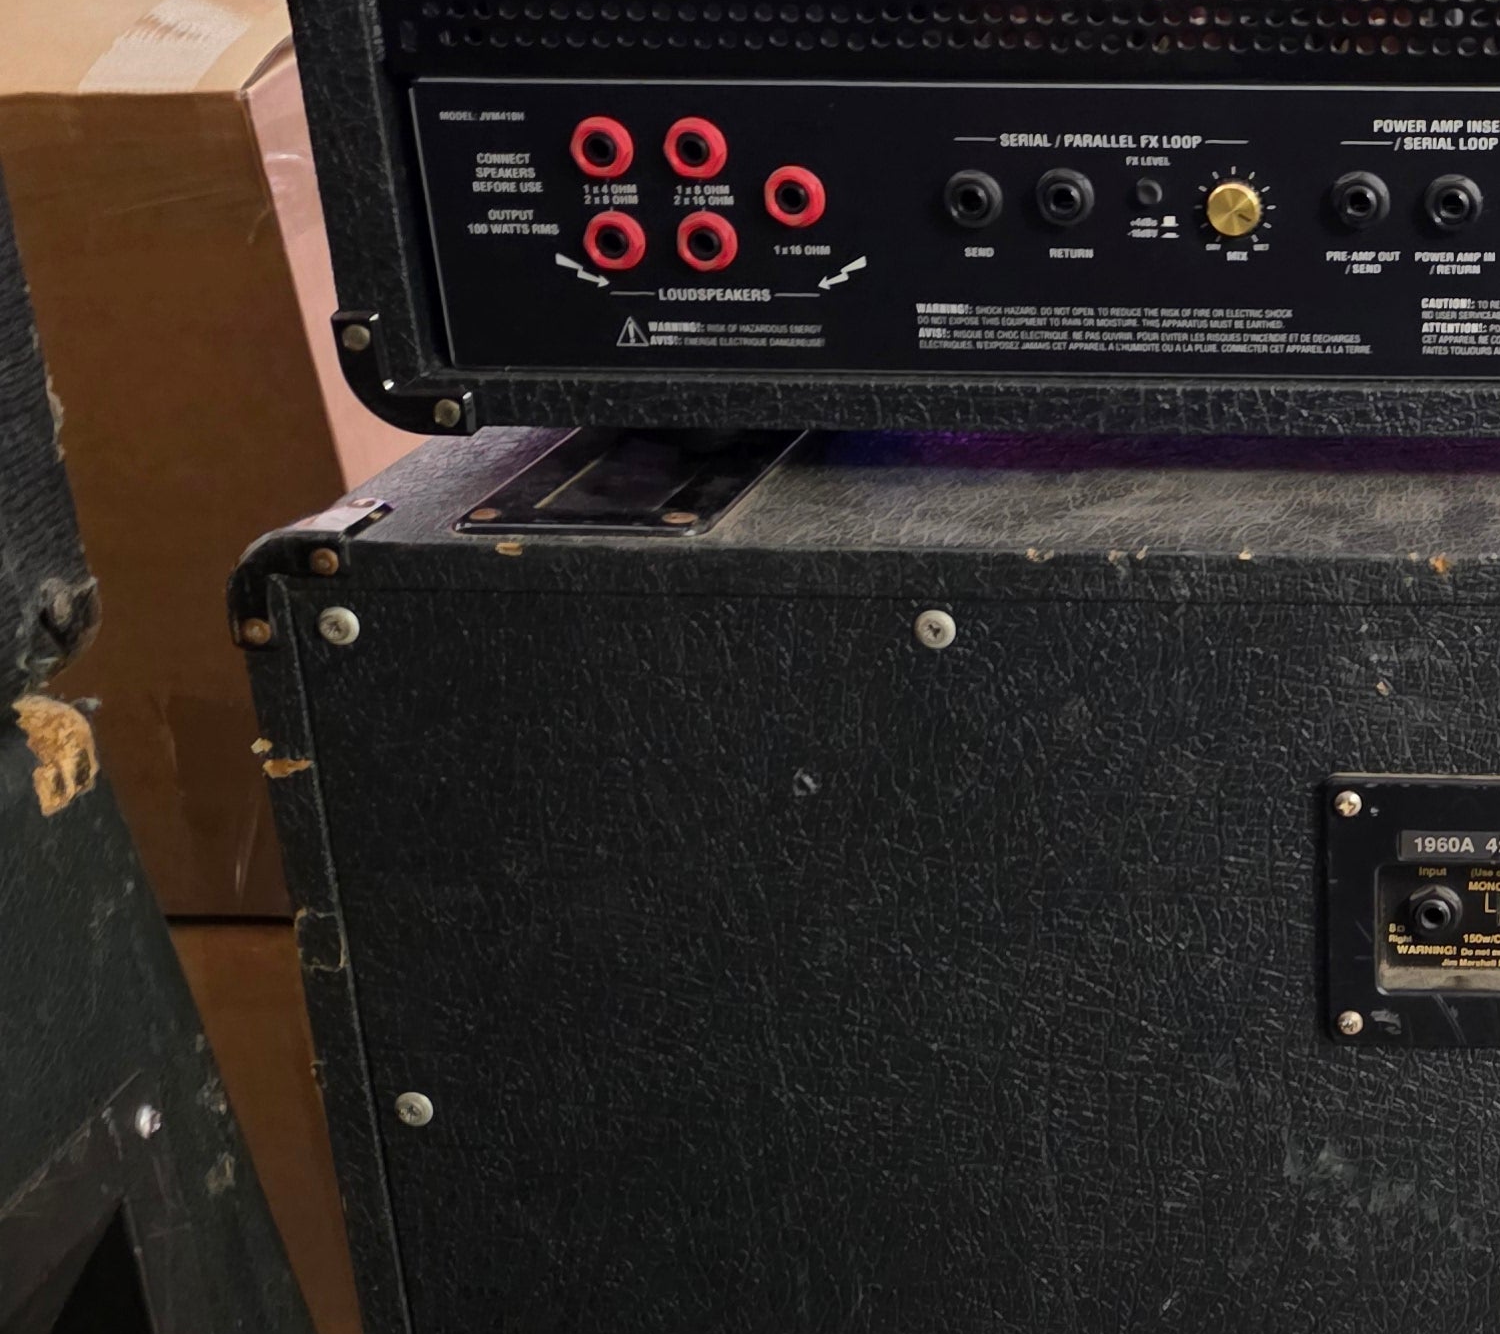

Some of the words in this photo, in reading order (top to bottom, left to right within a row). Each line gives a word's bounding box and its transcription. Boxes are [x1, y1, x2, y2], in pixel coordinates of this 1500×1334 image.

[1374, 120, 1427, 132] POWER
[1430, 120, 1464, 132] AMP
[1000, 133, 1052, 147] SERIAL
[1064, 134, 1138, 148] PARALLEL
[1140, 135, 1160, 148] FX
[1162, 135, 1202, 149] LOOP
[1404, 137, 1456, 150] SERIAL
[1459, 137, 1498, 150] LOOP
[477, 153, 530, 164] CONNECT
[1126, 156, 1138, 165] FX
[1141, 156, 1170, 165] LEVEL
[476, 167, 536, 178] SPEAKERS
[472, 181, 517, 192] BEFORE
[520, 182, 543, 192] USE
[583, 185, 589, 193] 1
[602, 184, 608, 193] 4
[611, 184, 637, 194] OHM
[694, 185, 701, 194] 8
[704, 185, 730, 195] OHM
[584, 195, 591, 204] 2
[603, 195, 609, 204] 8
[612, 195, 638, 204] OHM
[674, 195, 681, 205] 2
[692, 195, 706, 205] 16
[708, 195, 734, 205] OHM
[488, 209, 534, 220] OUTPUT
[468, 223, 488, 233] 100
[490, 224, 529, 234] WATTS
[532, 224, 560, 235] RMS
[774, 245, 780, 254] 1
[790, 245, 802, 254] 16
[804, 245, 830, 255] OHM
[964, 247, 994, 257] SEND
[1050, 248, 1094, 258] RETURN
[1326, 251, 1376, 261] PRE-AMP
[1378, 251, 1400, 261] OUT
[1415, 252, 1454, 262] POWER
[1456, 252, 1481, 262] AMP
[1484, 252, 1495, 261] IN
[1352, 264, 1381, 273] SEND
[1437, 265, 1480, 274] RETURN
[658, 288, 771, 301] LOUDSPEAKERS
[1413, 837, 1474, 853] 1960A
[1388, 934, 1412, 944] Right
[1397, 945, 1456, 955] WARNING!
[1460, 959, 1496, 967] Marshall
